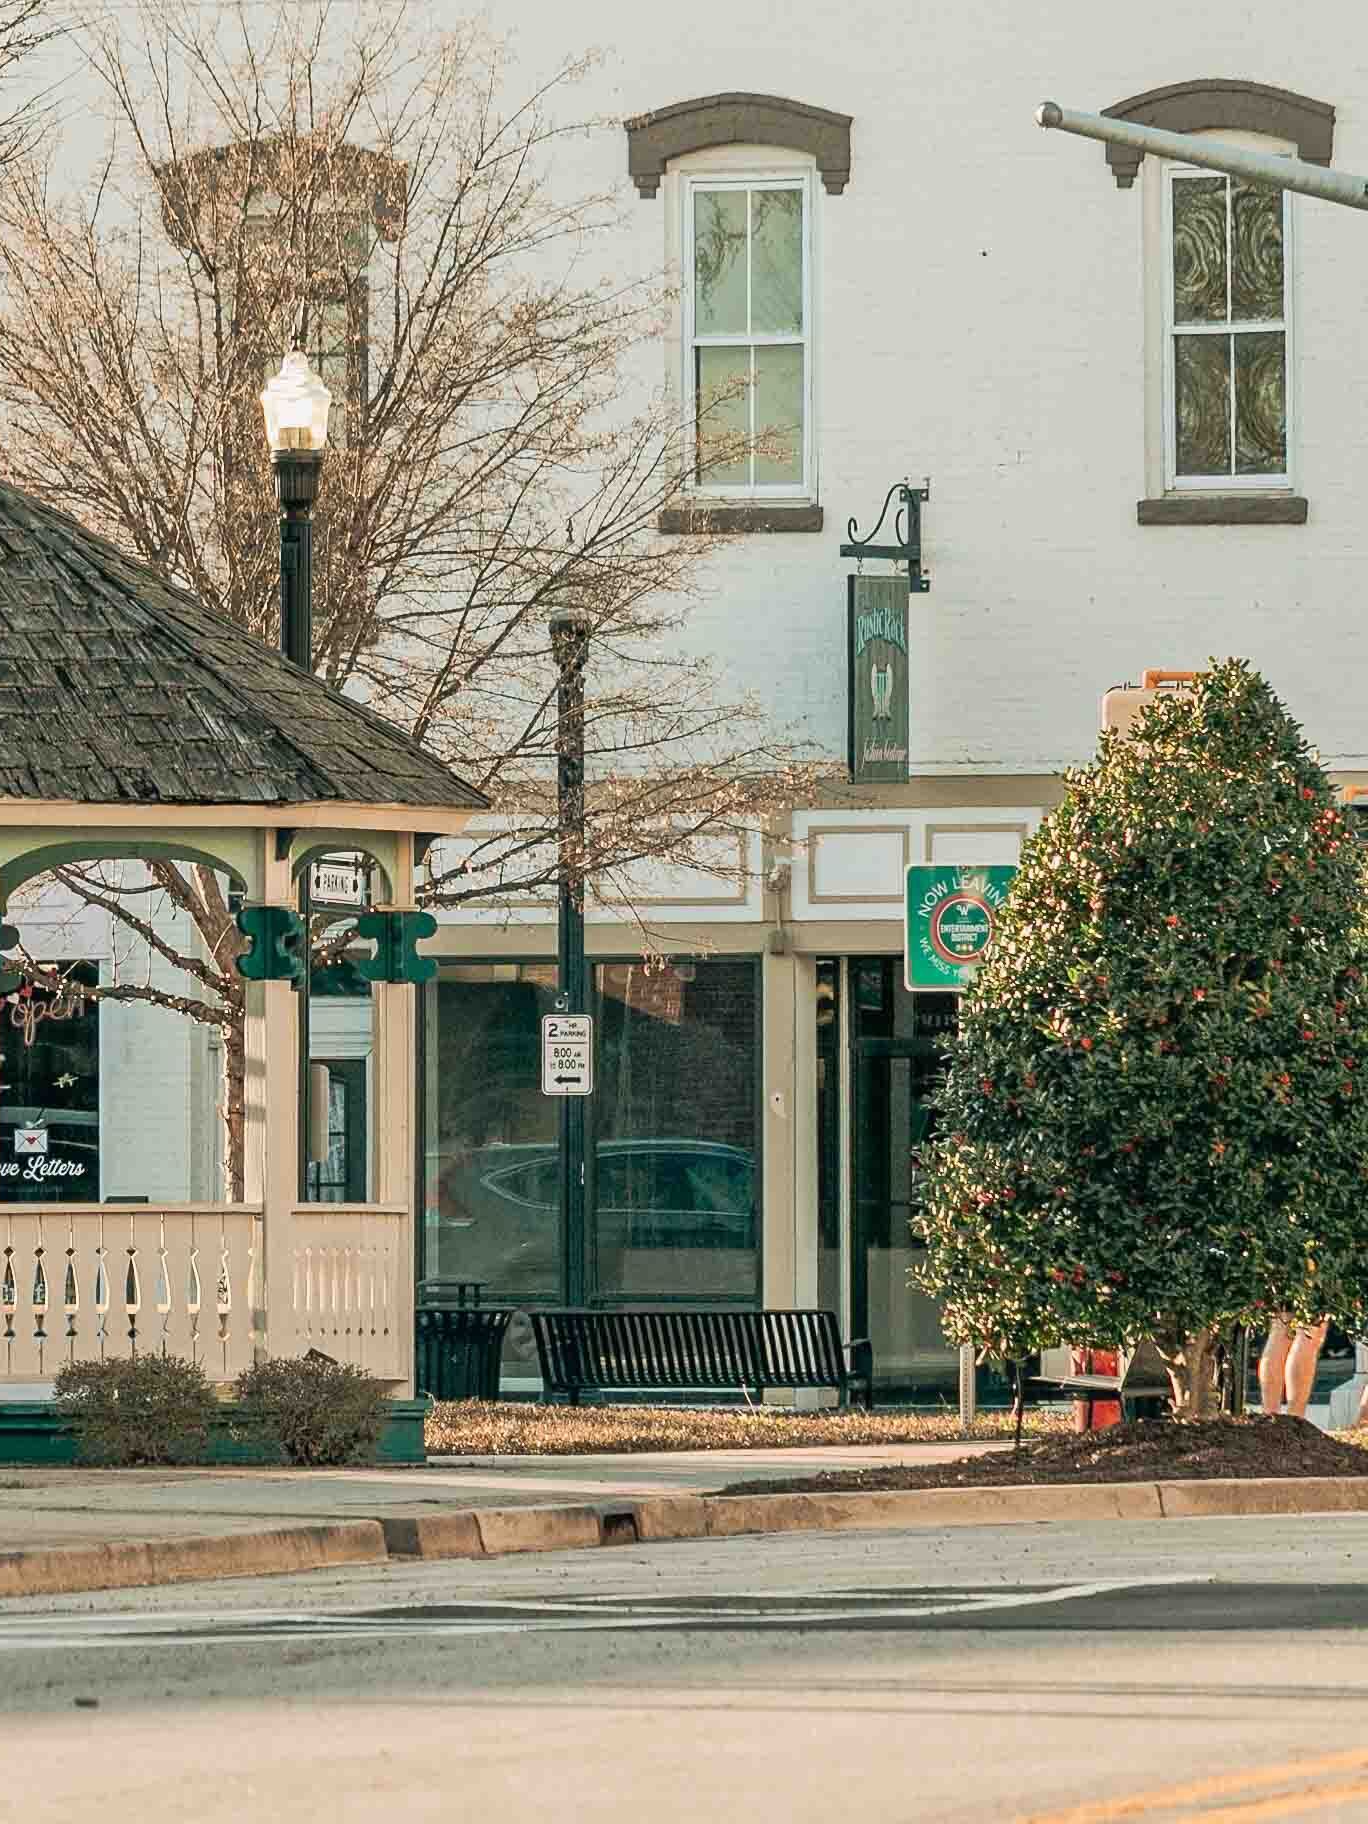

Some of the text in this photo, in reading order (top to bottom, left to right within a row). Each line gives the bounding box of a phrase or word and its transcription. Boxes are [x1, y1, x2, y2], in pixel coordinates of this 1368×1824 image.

[918, 880, 949, 918] NOW
[548, 1023, 558, 1037] 2
[23, 1155, 85, 1182] Letters
